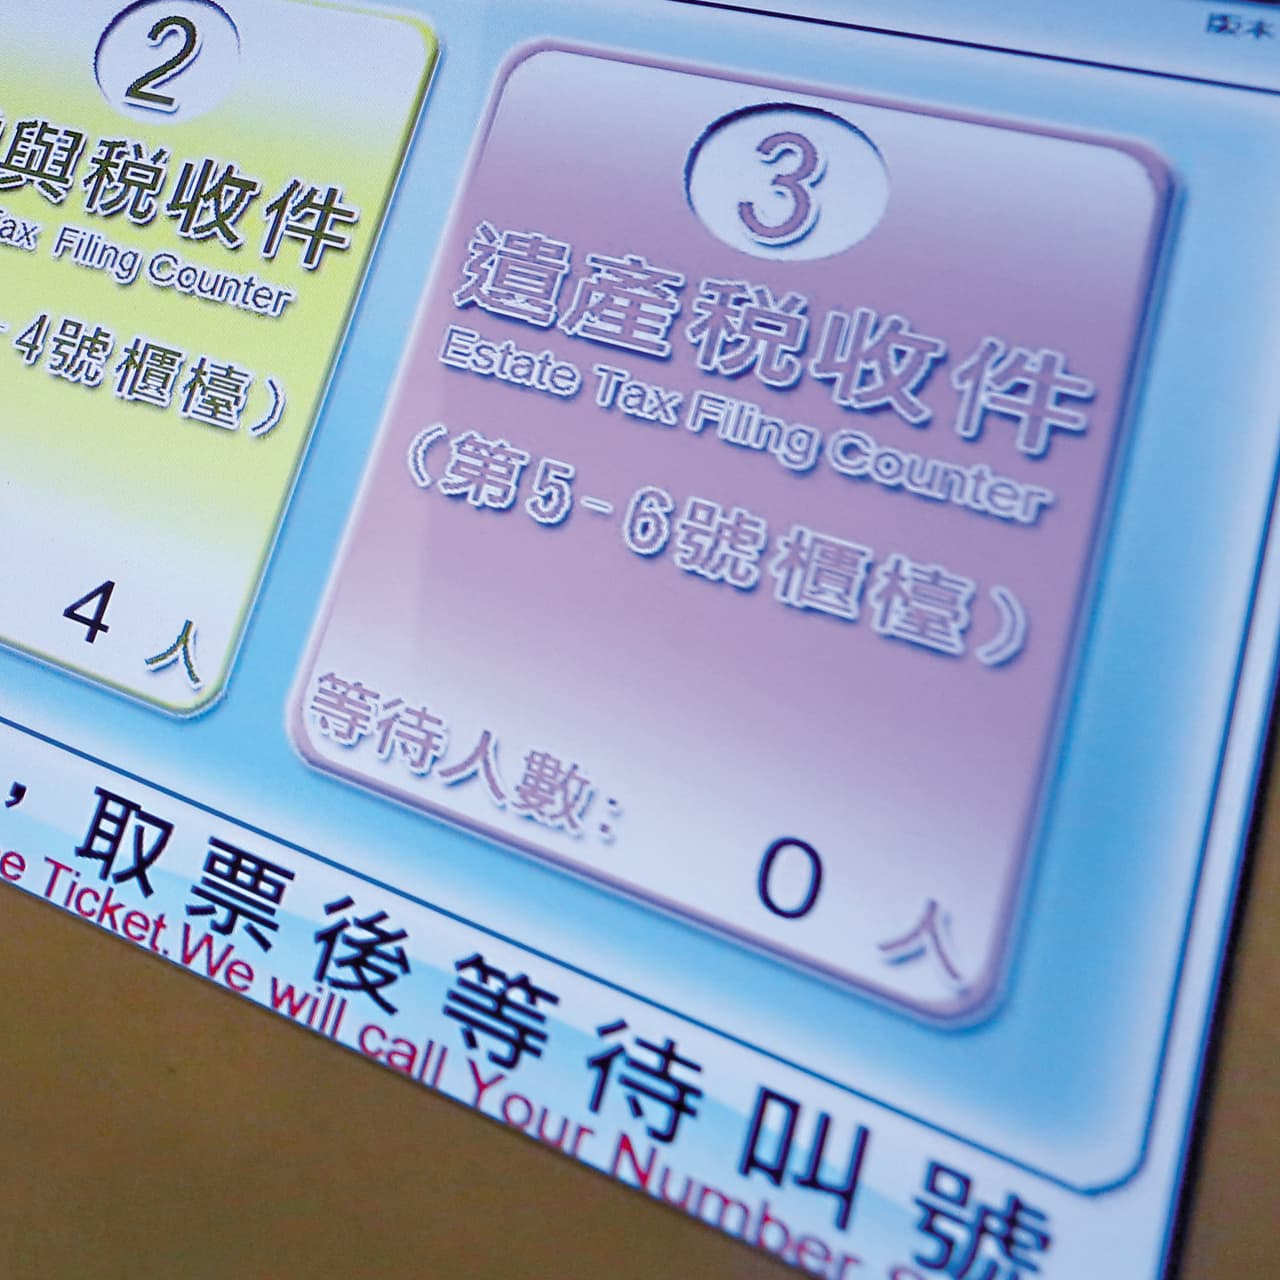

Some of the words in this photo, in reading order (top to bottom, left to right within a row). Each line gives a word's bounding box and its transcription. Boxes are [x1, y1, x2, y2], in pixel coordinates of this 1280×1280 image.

[123, 14, 202, 112] 2
[738, 129, 828, 248] 3
[53, 226, 141, 285] Filing
[148, 251, 295, 317] Counter
[438, 324, 582, 401] Estate
[592, 362, 683, 426] Tax
[686, 391, 822, 472] Filing
[827, 429, 1055, 525] Counter
[62, 579, 117, 645] 4
[144, 618, 202, 691] 人
[878, 897, 968, 996] 人
[269, 974, 348, 1039] will
[356, 1021, 449, 1087] call
[466, 1056, 596, 1158] Your
[610, 1131, 864, 1280] Number
